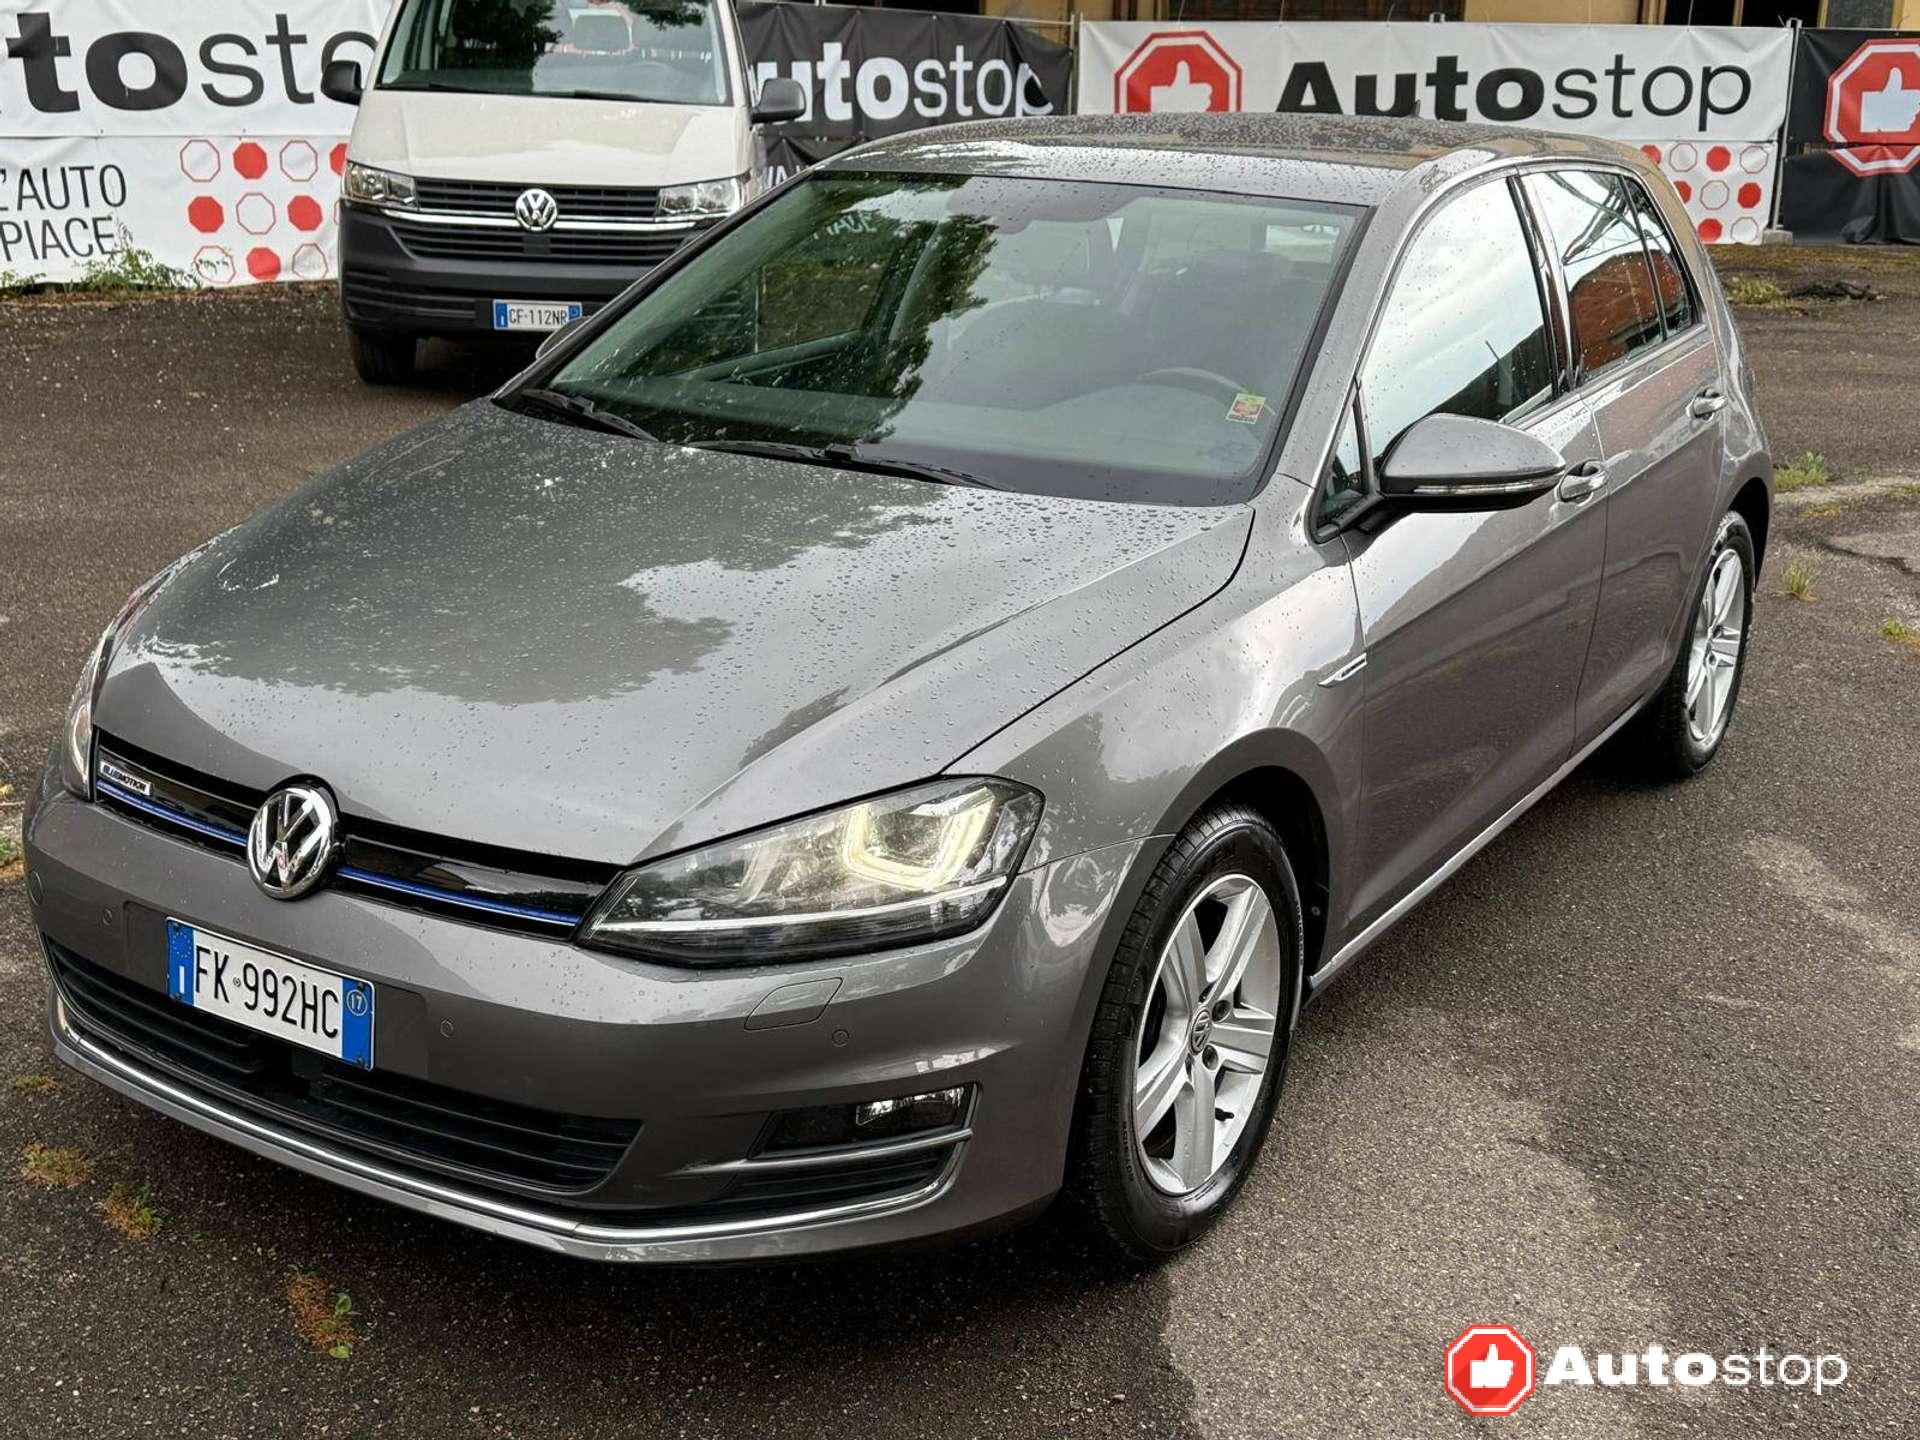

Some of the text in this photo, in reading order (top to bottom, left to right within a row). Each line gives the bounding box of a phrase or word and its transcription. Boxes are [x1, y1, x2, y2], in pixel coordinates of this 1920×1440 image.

[750, 42, 1054, 122] utostop
[1275, 54, 1752, 132] Autostop
[0, 164, 127, 211] 'AUTO
[0, 217, 118, 262] PIACE
